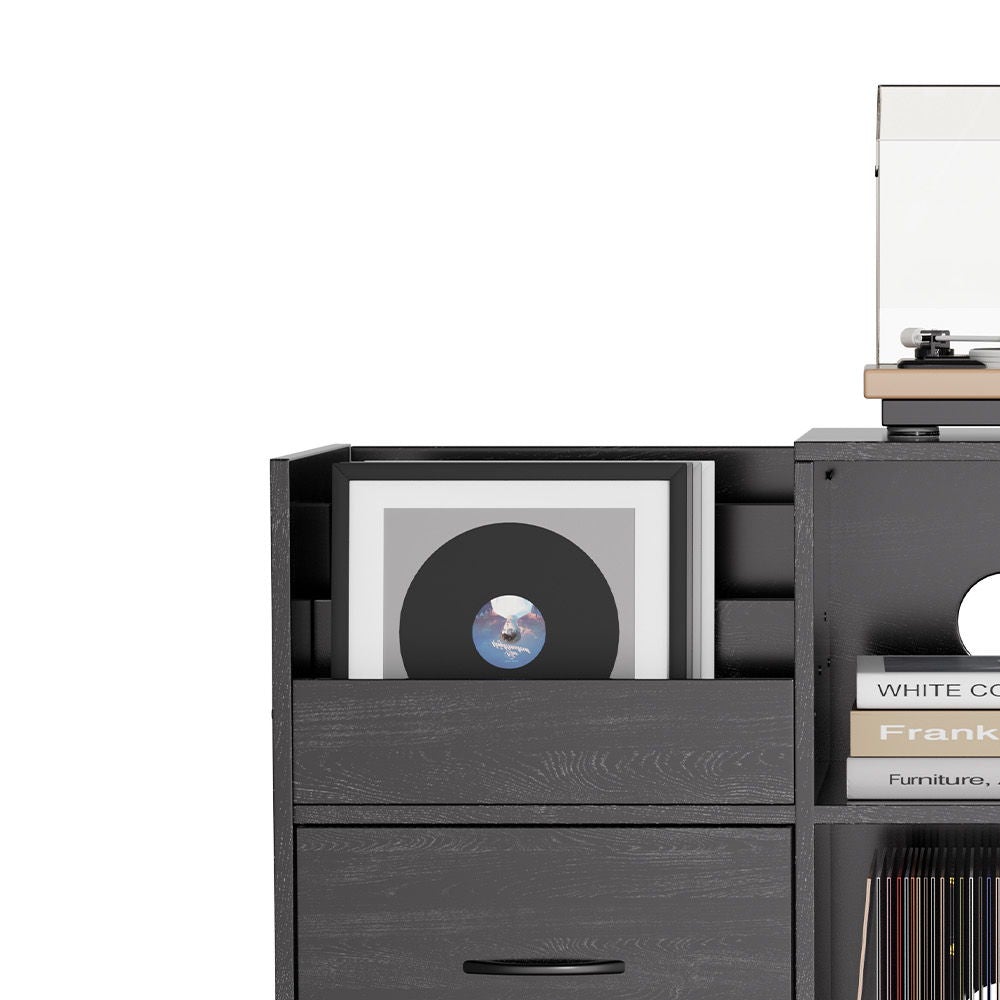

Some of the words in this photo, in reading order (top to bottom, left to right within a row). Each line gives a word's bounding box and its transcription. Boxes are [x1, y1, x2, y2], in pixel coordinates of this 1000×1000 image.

[877, 683, 961, 697] WHITE
[879, 724, 1000, 741] Frank
[889, 773, 991, 787] Furniture,
